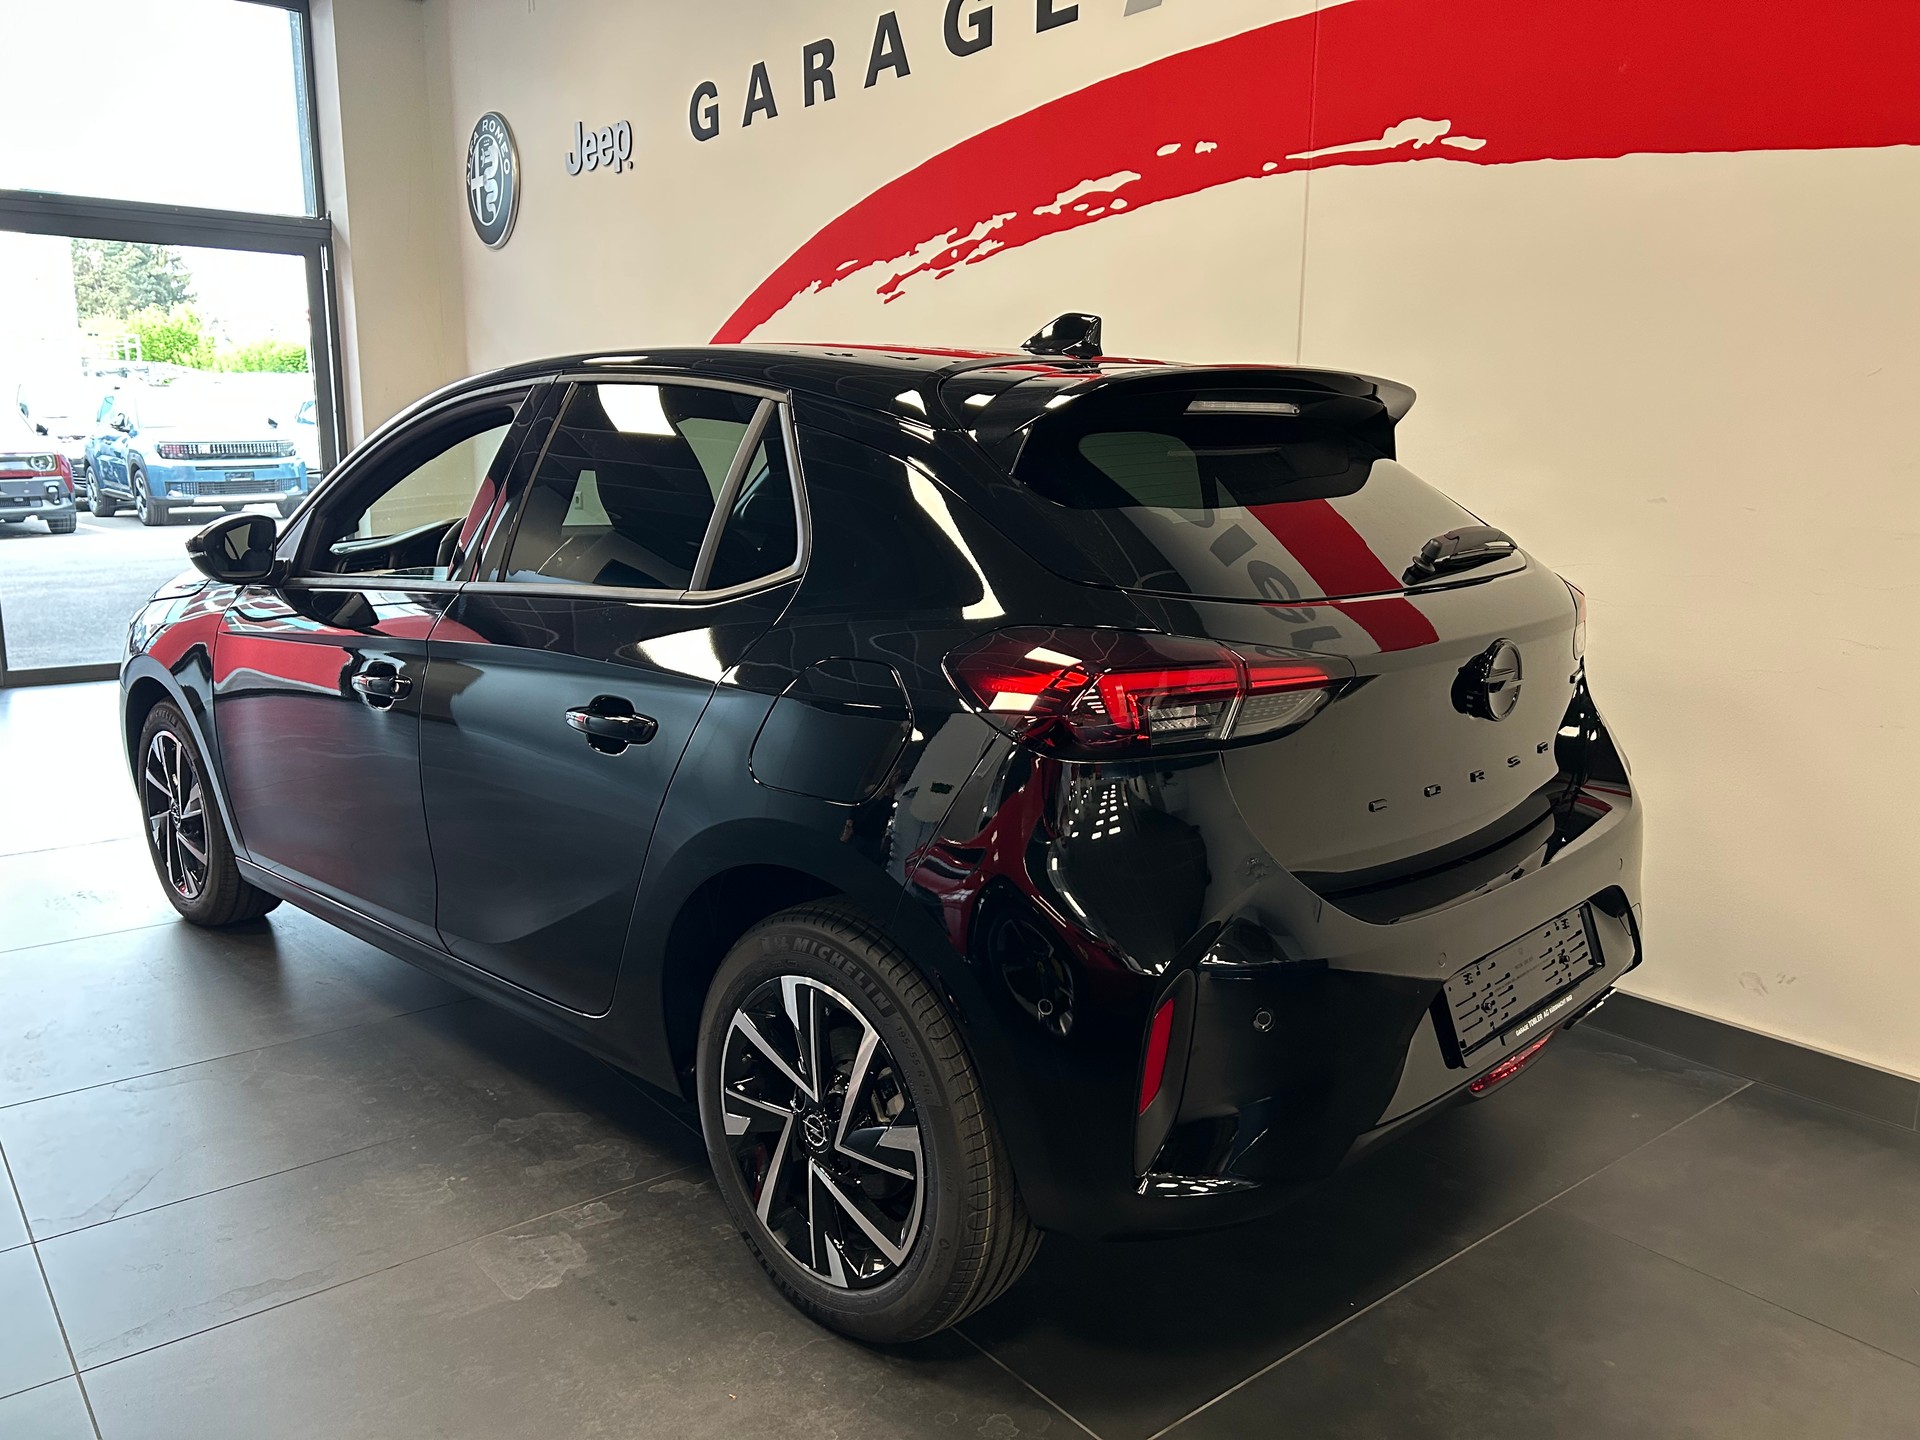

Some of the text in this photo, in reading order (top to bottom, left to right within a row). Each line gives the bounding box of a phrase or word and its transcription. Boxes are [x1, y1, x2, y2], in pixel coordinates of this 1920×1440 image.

[482, 119, 511, 175] ROMEO
[565, 120, 632, 175] Jeep
[1368, 741, 1549, 812] CORSA
[792, 936, 891, 1014] MICHELIN
